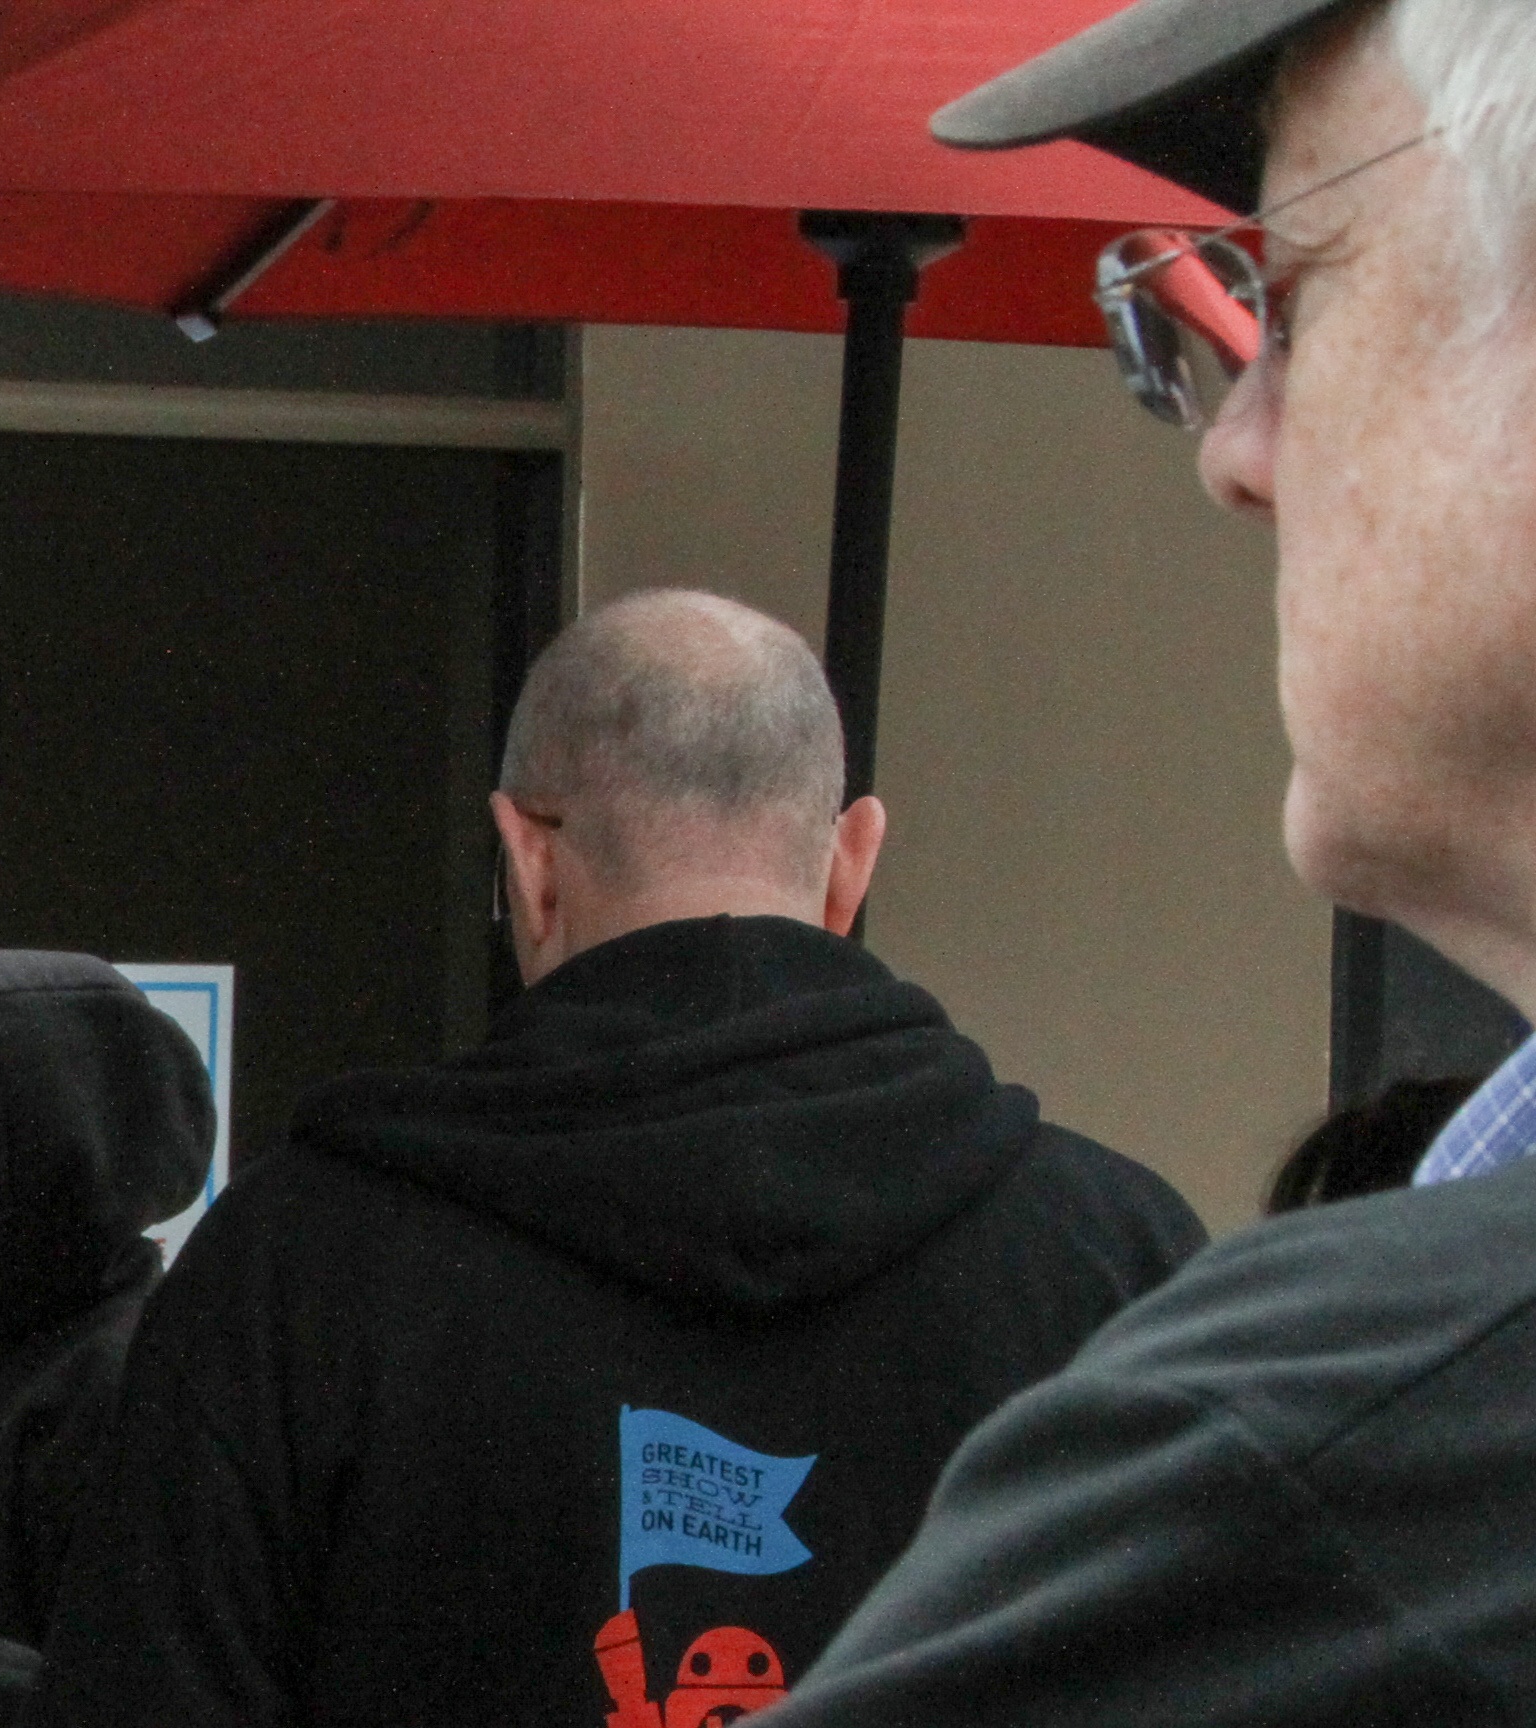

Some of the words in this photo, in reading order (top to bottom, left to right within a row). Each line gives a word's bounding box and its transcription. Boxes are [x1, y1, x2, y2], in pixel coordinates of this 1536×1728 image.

[642, 1442, 764, 1490] GREATEST
[642, 1467, 762, 1508] SHOW
[641, 1509, 674, 1532] ON
[682, 1516, 762, 1557] EARTH
[657, 1489, 762, 1532] TELL
